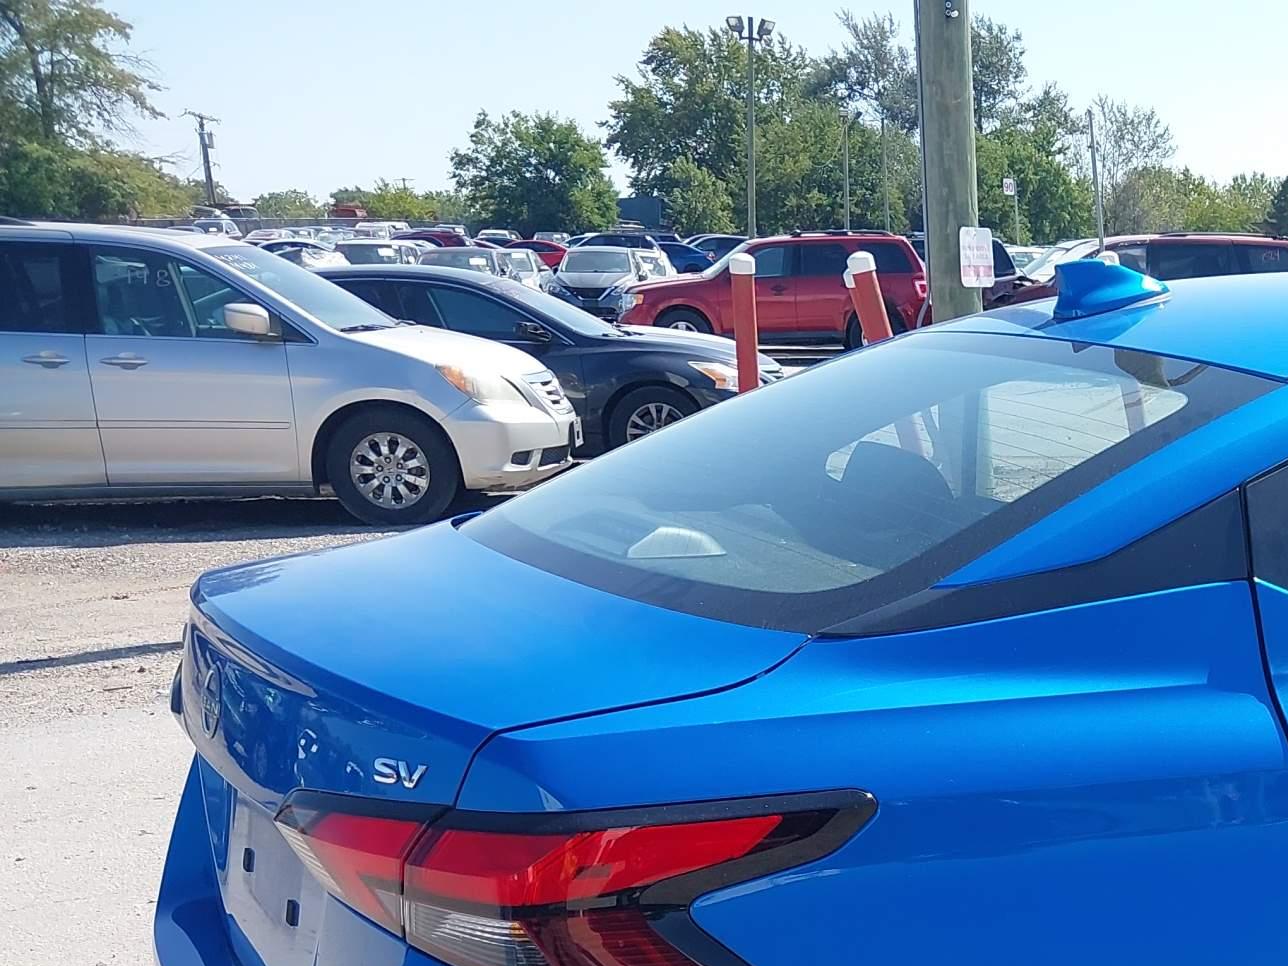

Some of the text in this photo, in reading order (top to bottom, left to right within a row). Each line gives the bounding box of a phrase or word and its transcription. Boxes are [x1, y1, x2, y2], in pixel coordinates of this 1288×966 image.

[1003, 182, 1014, 193] 90
[127, 268, 171, 288] 198
[373, 757, 428, 789] SV
